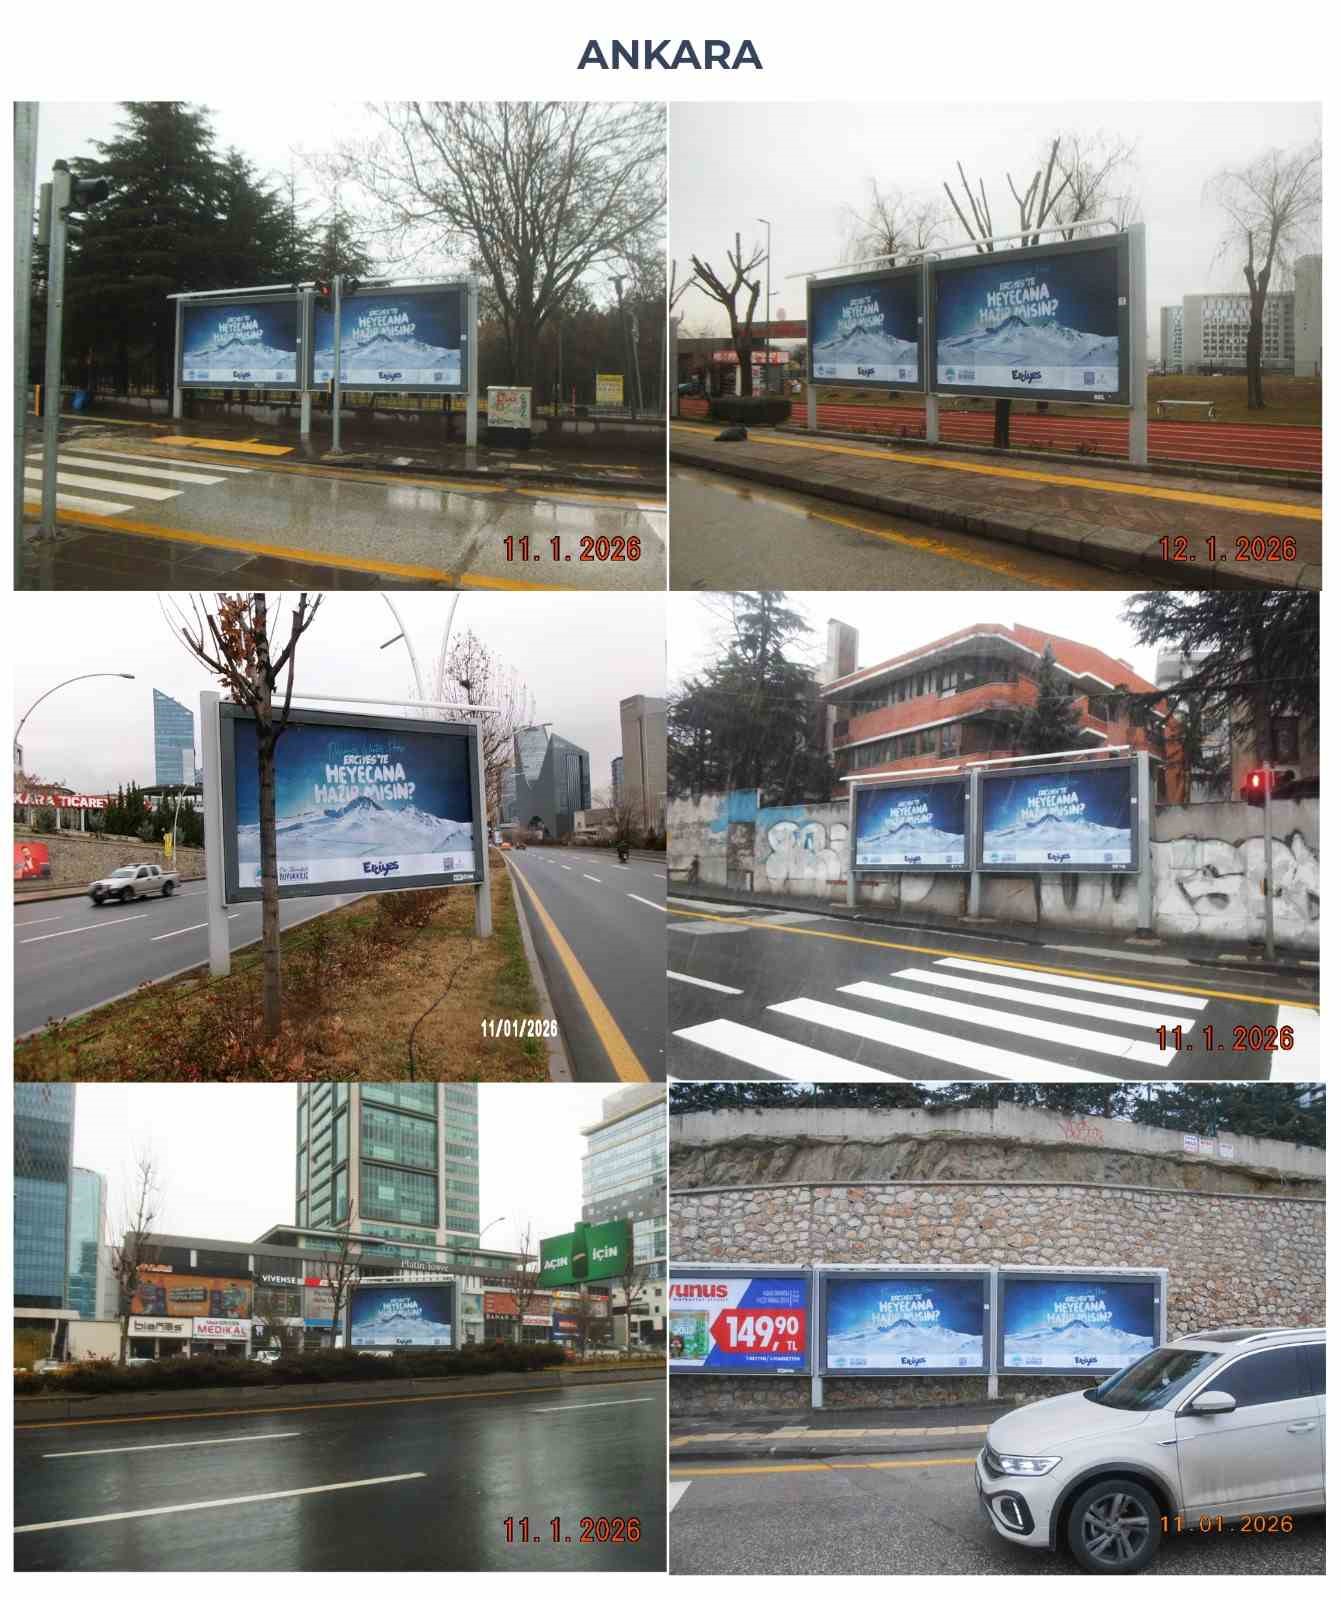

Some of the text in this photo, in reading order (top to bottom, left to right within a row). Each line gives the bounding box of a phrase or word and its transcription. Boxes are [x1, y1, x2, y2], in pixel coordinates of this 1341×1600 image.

[987, 283, 1049, 307] HEYECANA
[325, 762, 406, 784] HEYECANA
[364, 782, 415, 800] MISIN?
[592, 1245, 618, 1261] İÇİN
[879, 1299, 933, 1313] HEYECANA
[787, 1340, 798, 1351] TL
